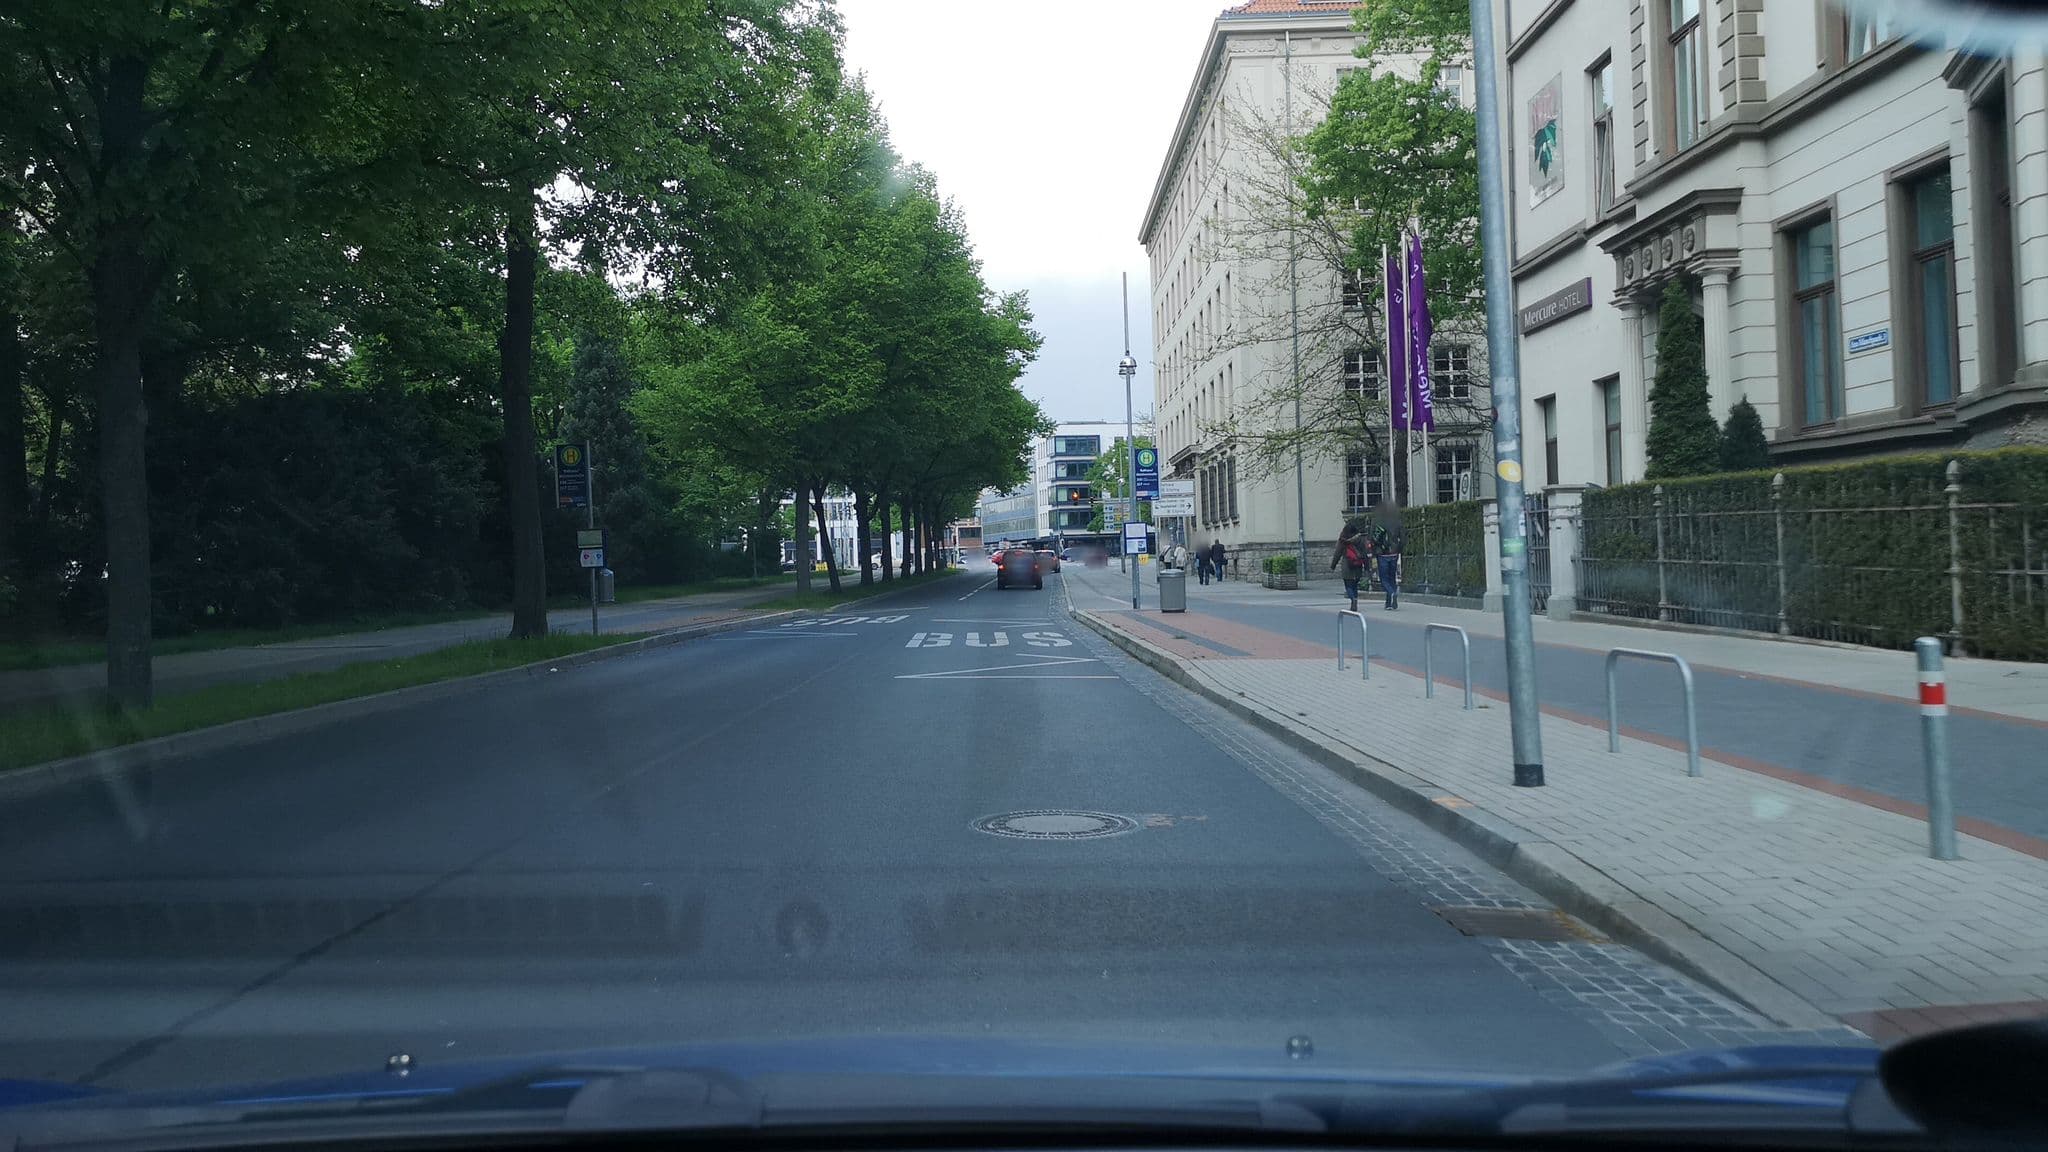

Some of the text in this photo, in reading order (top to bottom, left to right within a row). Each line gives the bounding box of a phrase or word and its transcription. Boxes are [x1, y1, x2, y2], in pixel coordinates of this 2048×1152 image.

[1524, 291, 1581, 328] Mercure HOTEL
[905, 632, 1073, 648] BUS
